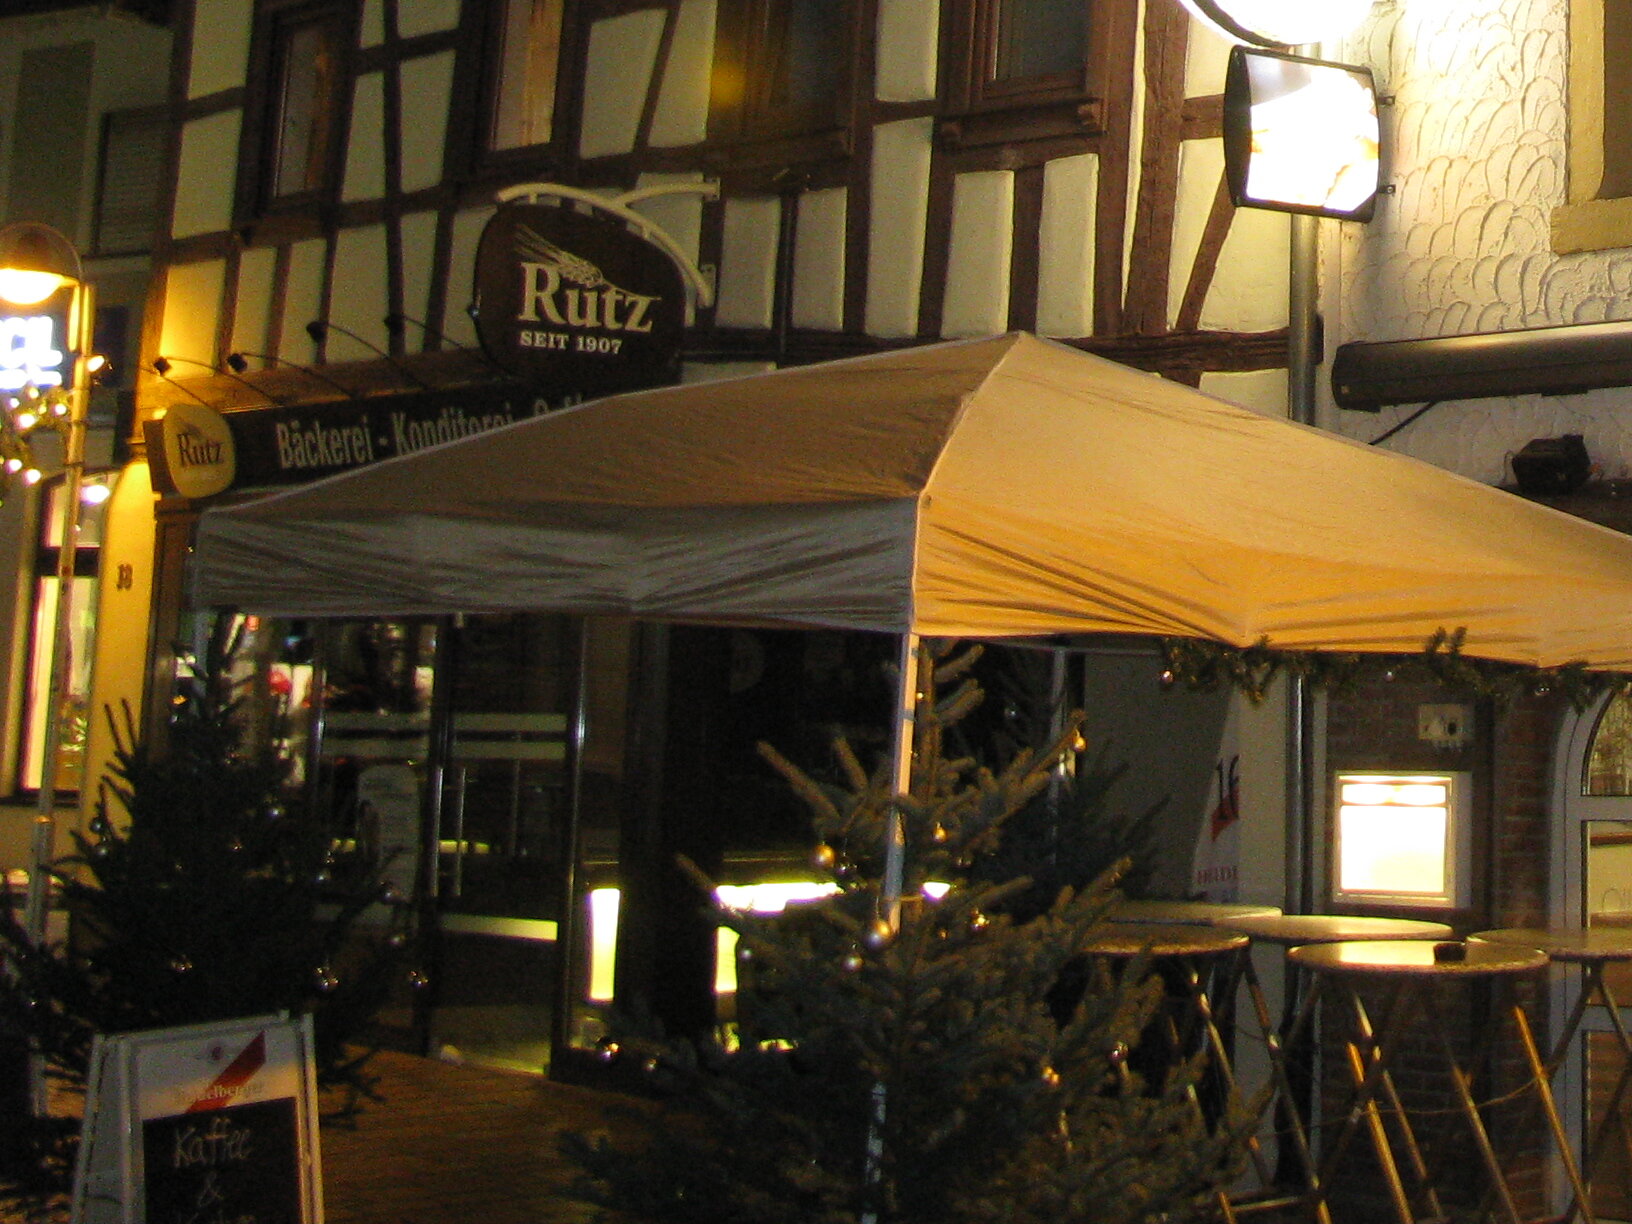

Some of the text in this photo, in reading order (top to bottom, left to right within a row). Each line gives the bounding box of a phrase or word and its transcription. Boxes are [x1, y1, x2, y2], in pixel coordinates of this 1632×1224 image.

[517, 261, 654, 334] Rutz
[520, 330, 624, 355] SEIT 1907
[177, 433, 225, 468] Rutz
[275, 414, 376, 471] Bäckerei
[174, 1116, 254, 1169] Kaffee
